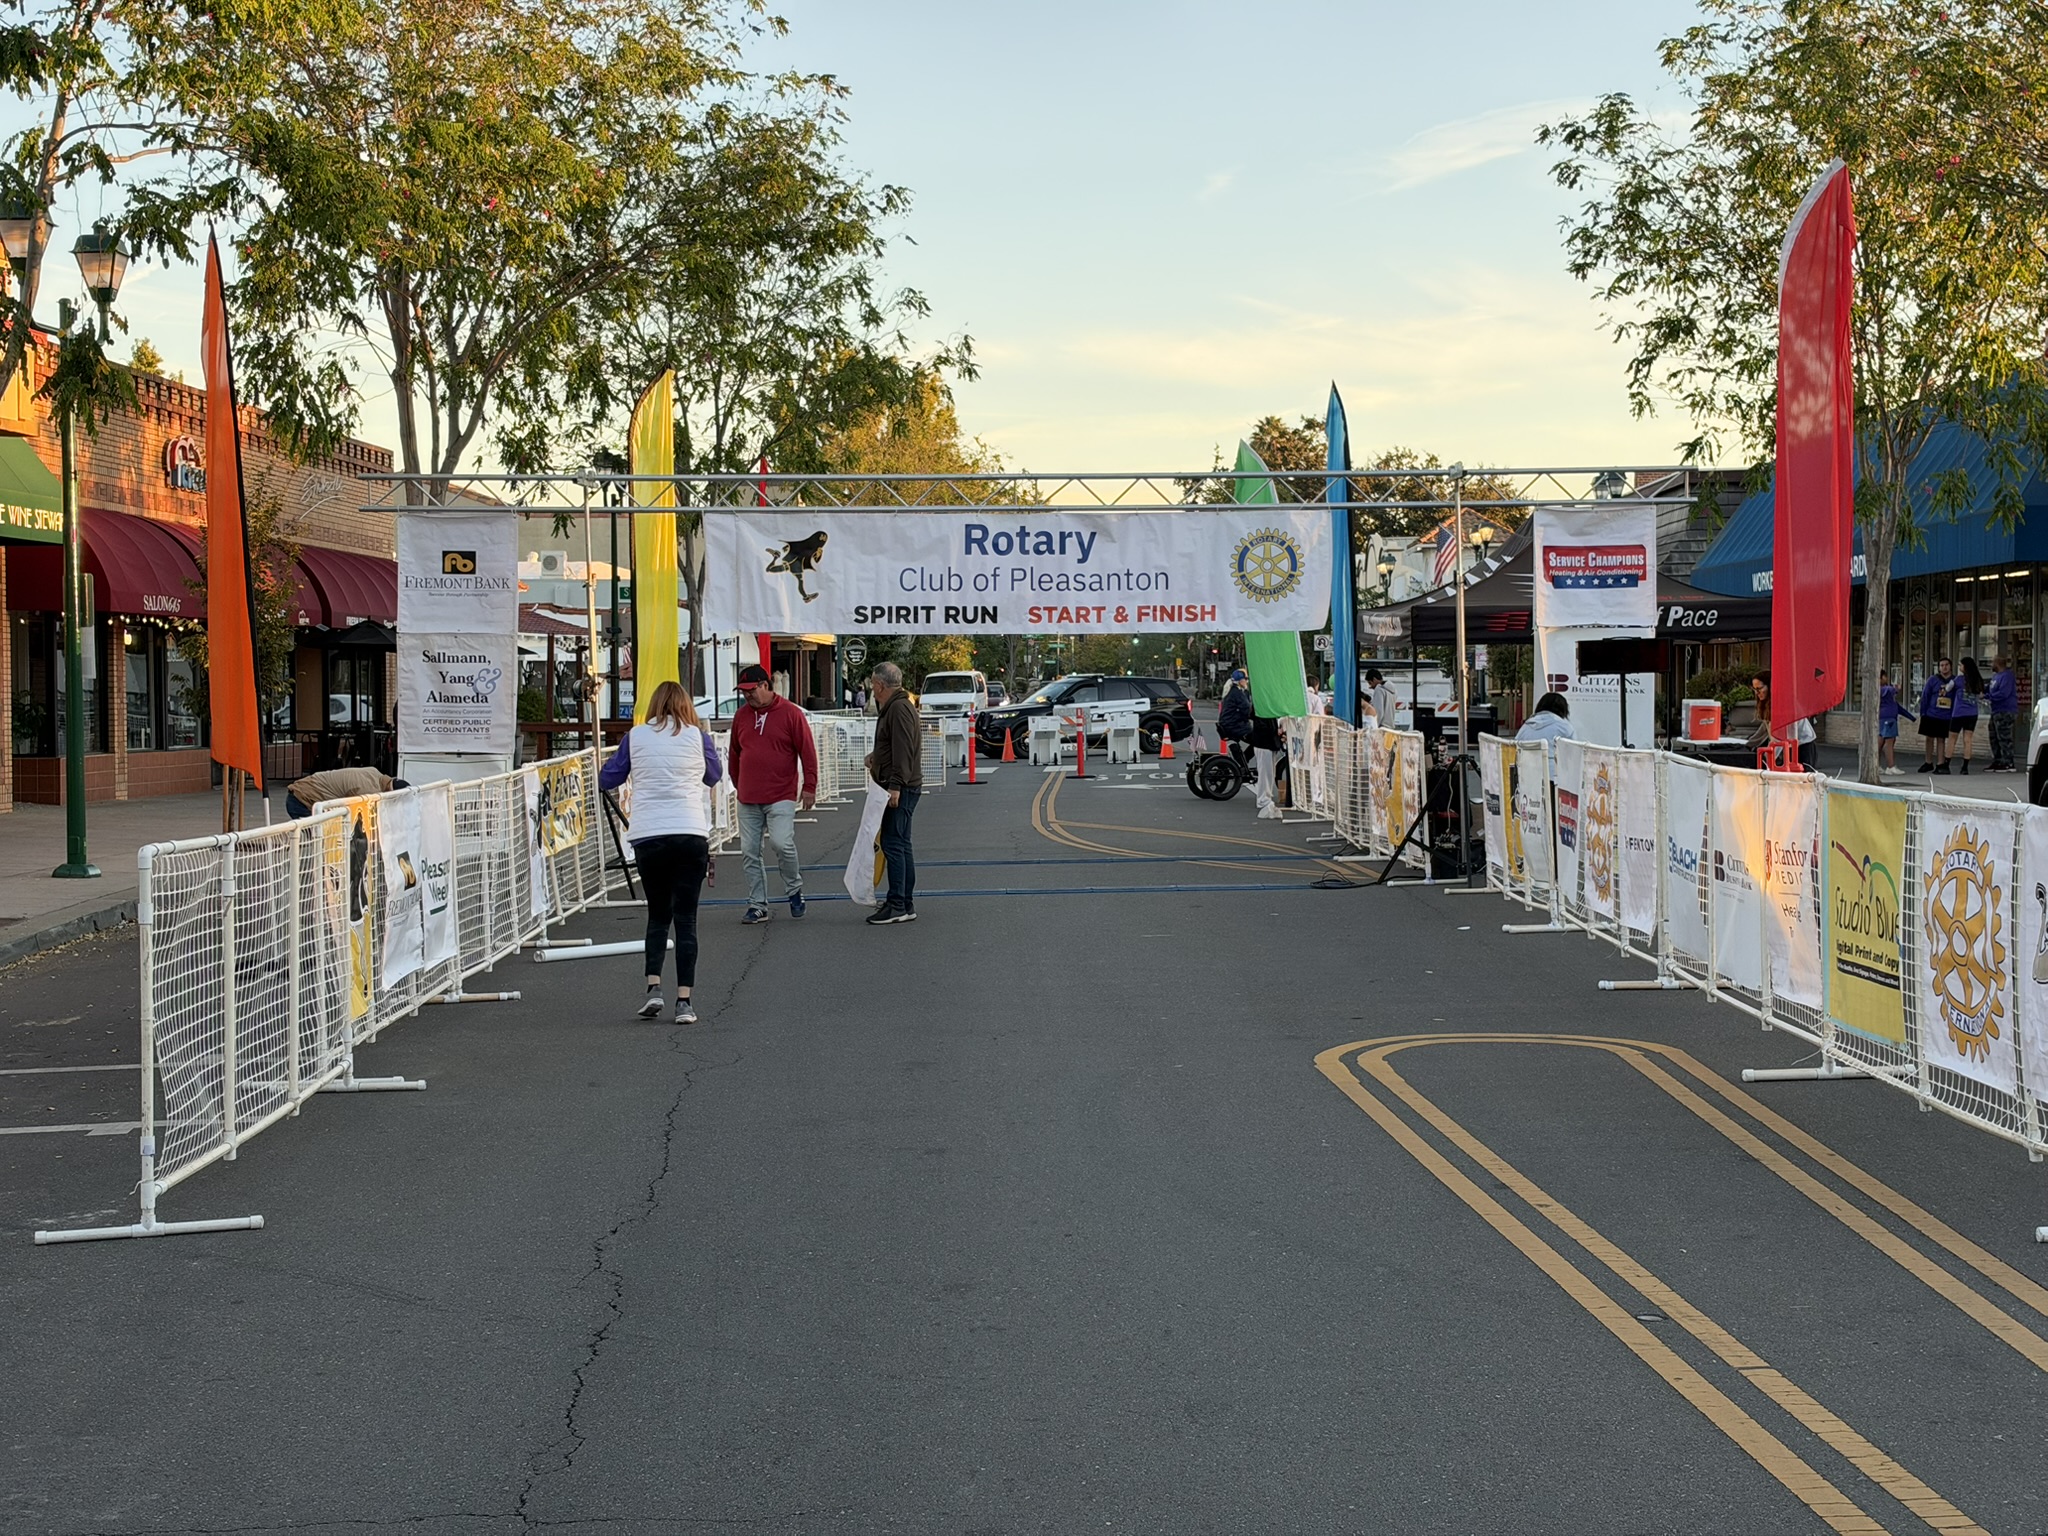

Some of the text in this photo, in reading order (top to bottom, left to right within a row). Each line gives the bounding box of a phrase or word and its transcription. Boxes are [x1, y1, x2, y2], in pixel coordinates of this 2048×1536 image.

[8, 504, 32, 529] WINE
[964, 523, 1097, 563] Rotary
[1252, 536, 1282, 545] ROTARY
[1549, 551, 1645, 567] SERVICE CHAMPIONS
[899, 566, 1170, 593] Club of Pleasanton
[1549, 569, 1576, 577] Heating
[1596, 567, 1644, 577] Conditioning
[404, 575, 511, 590] FREMONT BANK
[1241, 576, 1294, 595] INTERNATIONAL
[853, 604, 1217, 624] SPIRIT RUN START & FINISH
[1666, 606, 1719, 628] Pace
[422, 649, 492, 666] Sallmann,
[438, 667, 502, 695] Yang &
[1572, 686, 1619, 694] BUSINESS
[426, 690, 489, 704] Alameda
[1834, 886, 1871, 936] Studio
[1855, 944, 1872, 962] Print
[1873, 952, 1884, 965] and
[1884, 953, 1900, 973] Copy
